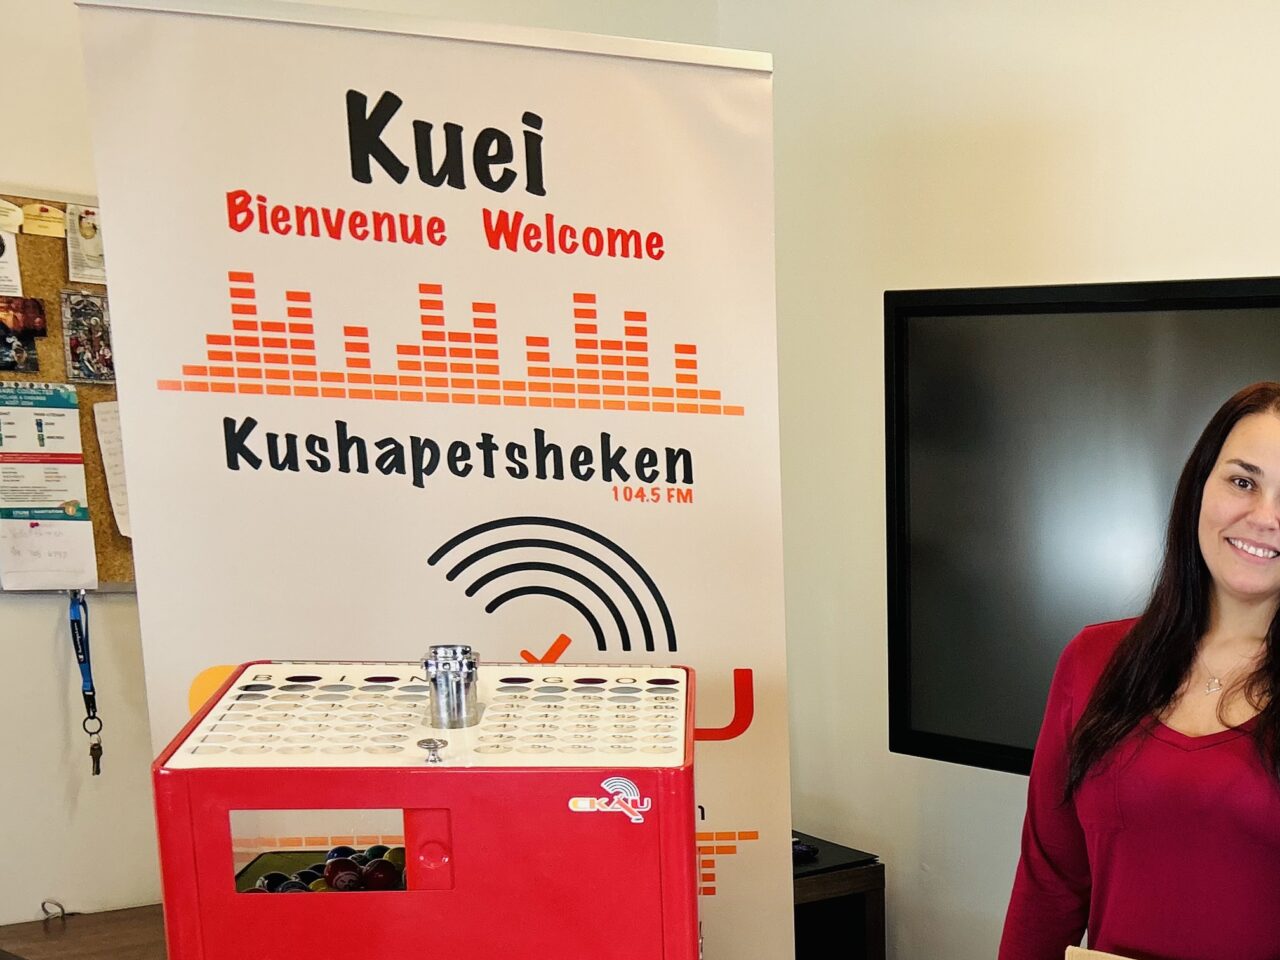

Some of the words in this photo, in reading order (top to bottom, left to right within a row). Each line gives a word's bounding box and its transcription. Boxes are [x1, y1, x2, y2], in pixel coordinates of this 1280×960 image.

[345, 89, 546, 197] Kuei
[225, 189, 447, 246] Bienvenue
[482, 207, 665, 261] Welcome
[222, 416, 694, 488] Kushapetsheken
[612, 486, 660, 502] 104.5
[666, 487, 694, 503] FM
